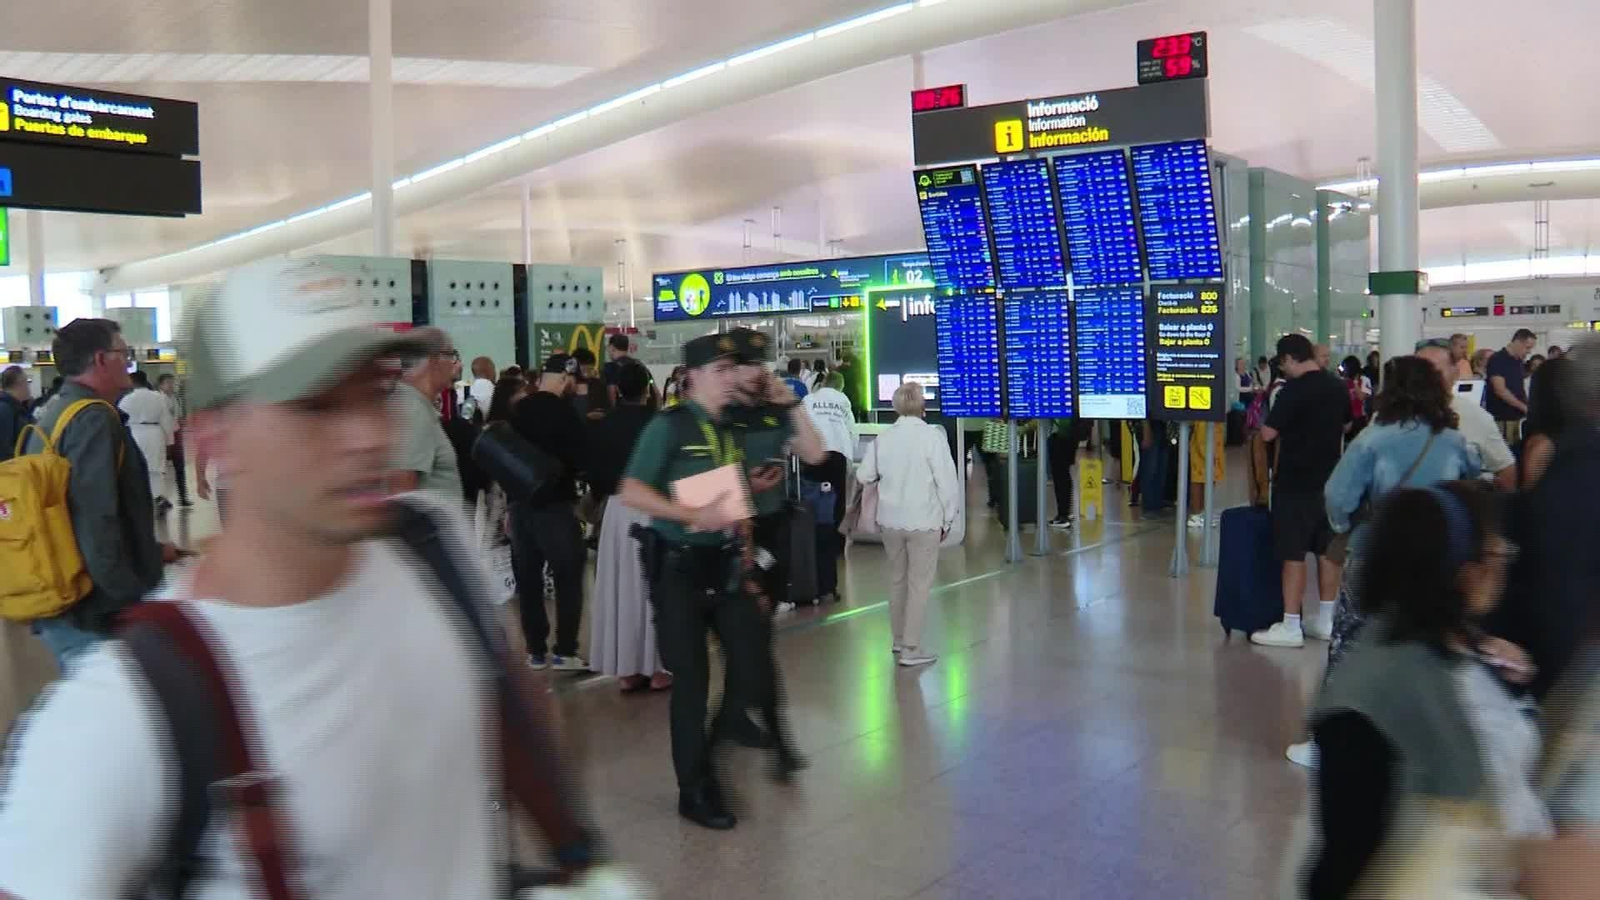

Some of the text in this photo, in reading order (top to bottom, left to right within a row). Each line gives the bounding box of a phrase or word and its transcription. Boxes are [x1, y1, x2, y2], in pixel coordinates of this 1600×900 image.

[14, 103, 92, 124] Boarding gates
[59, 94, 154, 119] d'embarcament
[1027, 94, 1099, 118] Informació
[14, 117, 148, 144] Puertas de embarque
[1028, 114, 1086, 132] Information
[1029, 127, 1109, 148] Información
[906, 269, 923, 283] 02
[1158, 306, 1198, 314] Facturación
